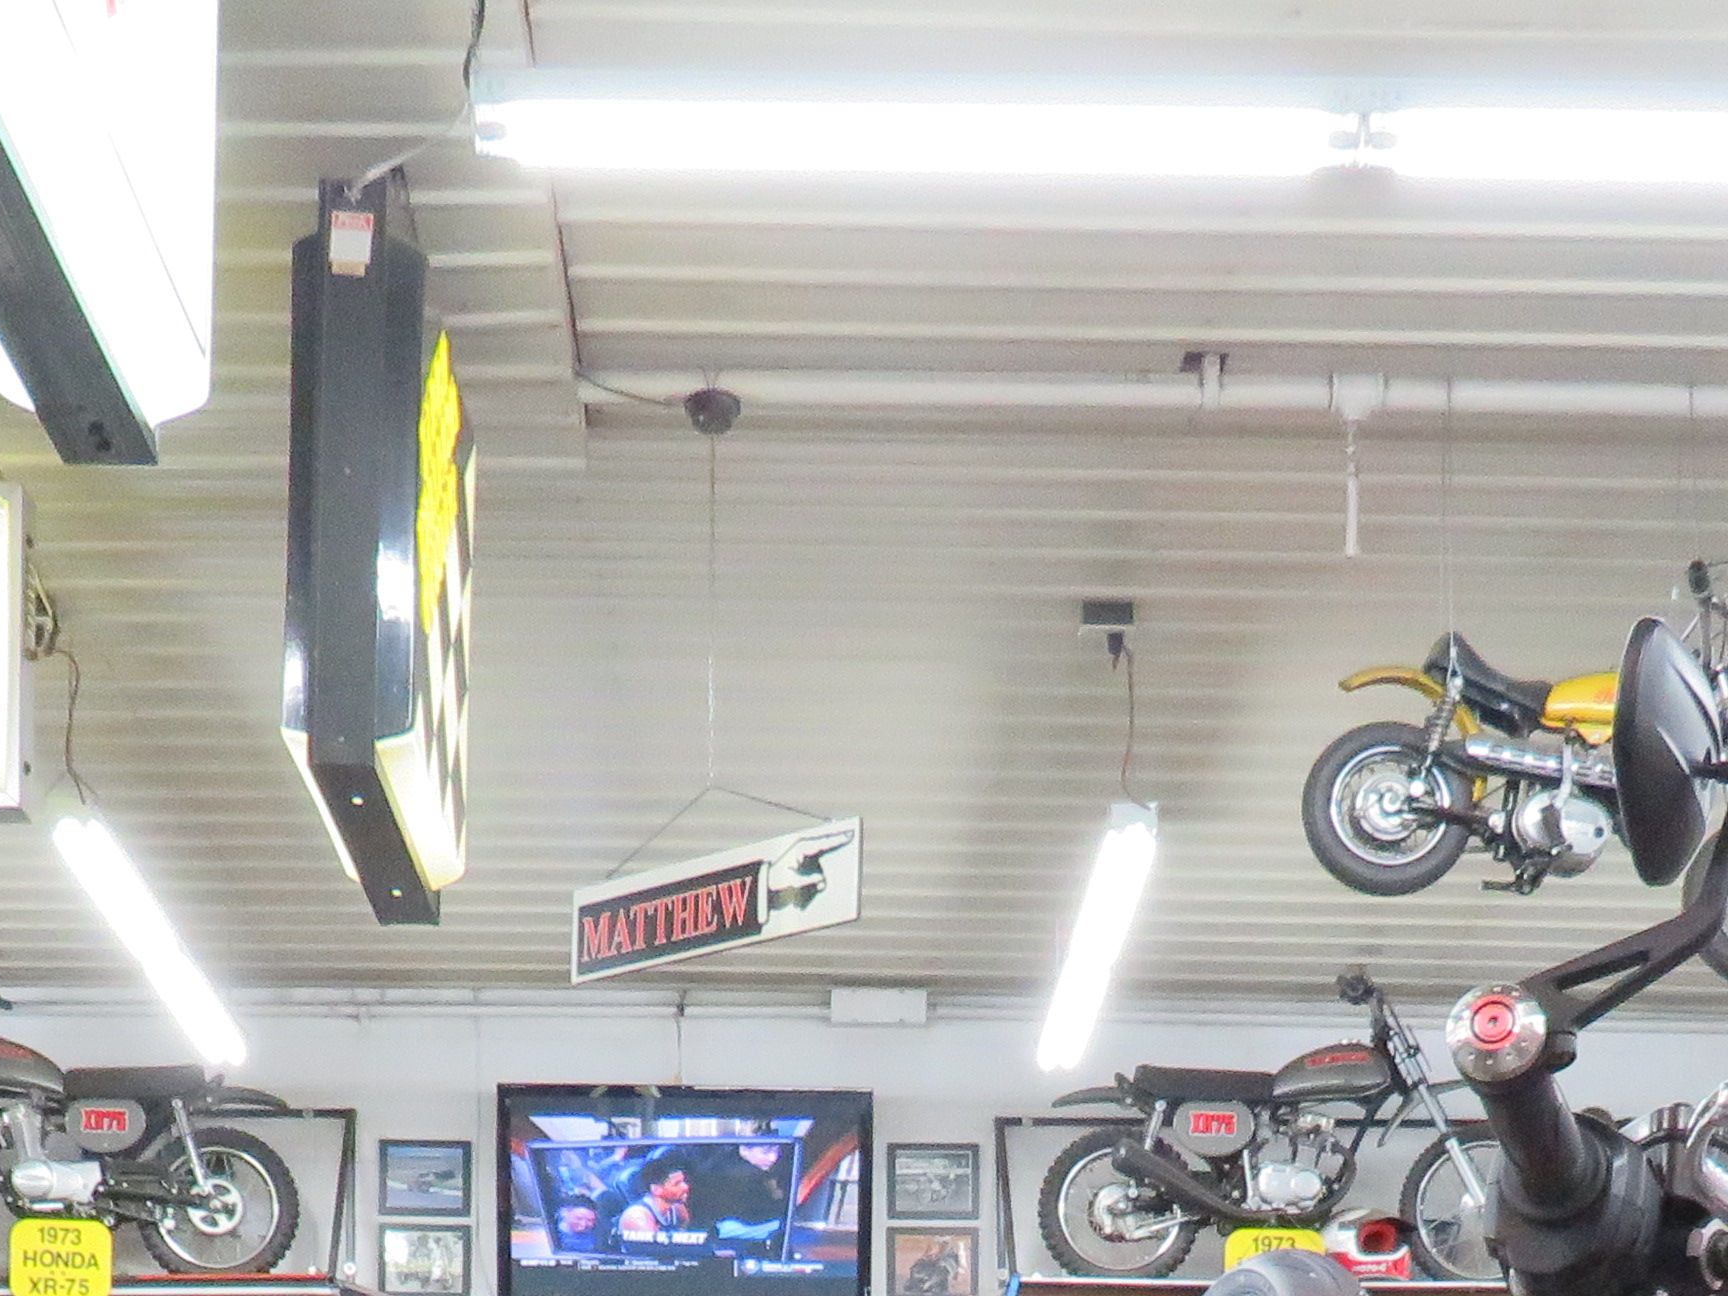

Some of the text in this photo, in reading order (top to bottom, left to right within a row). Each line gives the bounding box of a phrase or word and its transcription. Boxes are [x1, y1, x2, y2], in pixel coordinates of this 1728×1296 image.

[579, 876, 753, 963] MATTHEW
[38, 1227, 82, 1246] 1973
[672, 1231, 709, 1245] NEXT
[1251, 1236, 1296, 1251] 1973
[22, 1249, 101, 1271] HONDA
[29, 1277, 90, 1296] XR-75
